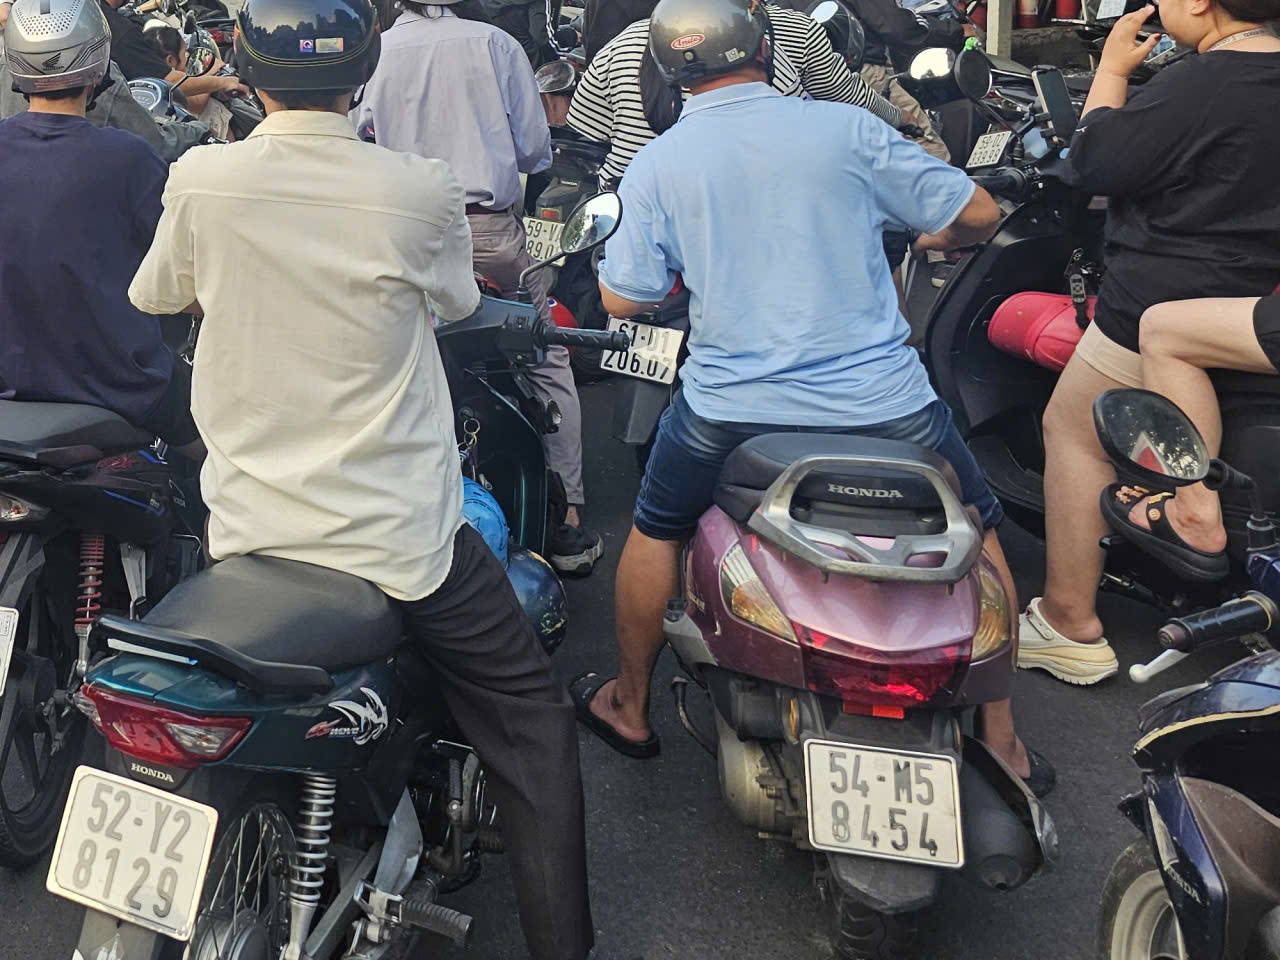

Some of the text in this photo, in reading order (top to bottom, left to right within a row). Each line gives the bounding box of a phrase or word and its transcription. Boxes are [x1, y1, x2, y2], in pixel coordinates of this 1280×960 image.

[827, 483, 905, 498] HONDA
[130, 762, 175, 783] HONDA
[828, 750, 935, 807] 54-M5
[87, 781, 192, 863] 52-Y2
[831, 799, 939, 857] 8454
[72, 838, 179, 918] 8129
